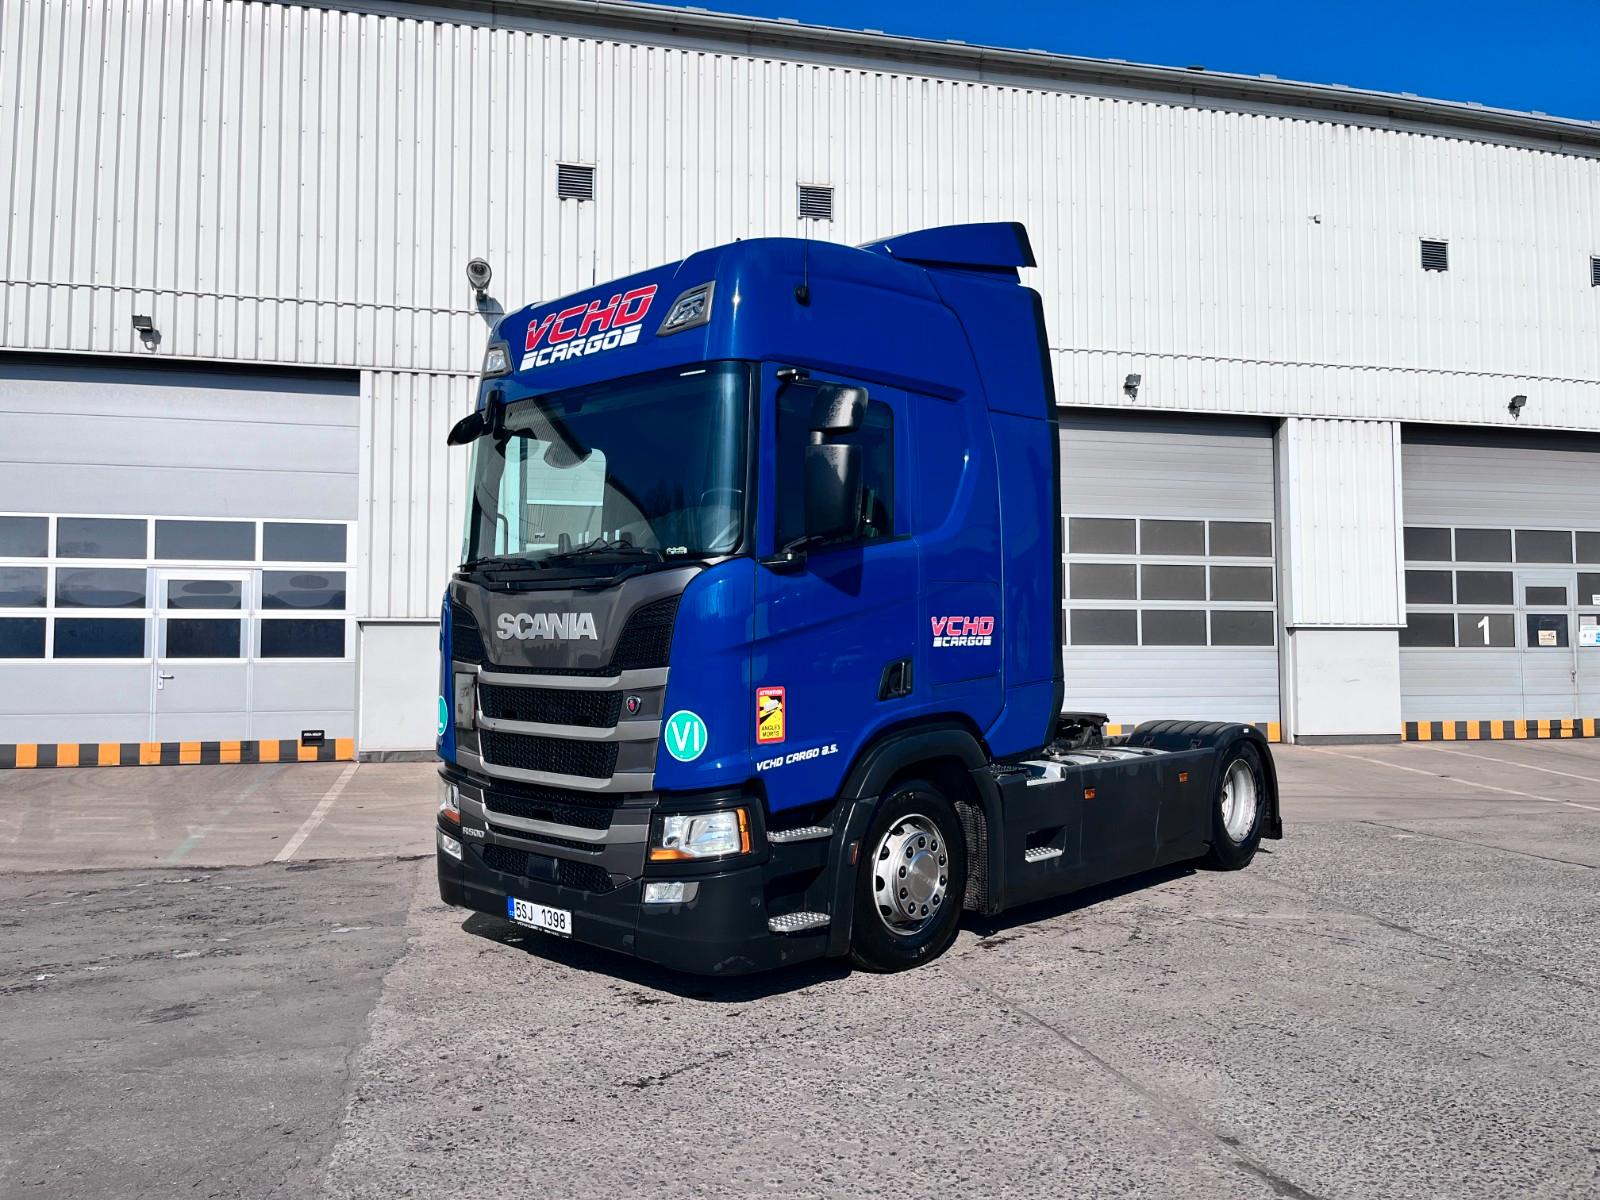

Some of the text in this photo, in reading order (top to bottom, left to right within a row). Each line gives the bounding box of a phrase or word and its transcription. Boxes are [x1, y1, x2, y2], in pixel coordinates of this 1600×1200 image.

[525, 284, 658, 351] VCHO
[536, 329, 622, 367] CARGO
[496, 612, 598, 641] SCANIA
[931, 616, 995, 636] VCHO
[1477, 615, 1490, 645] 1
[942, 636, 984, 647] CARGO
[671, 721, 700, 752] VI
[756, 757, 784, 772] VCHO
[786, 748, 820, 765] CARGO
[462, 826, 485, 838] R500
[516, 901, 533, 921] 5SJ
[541, 908, 566, 930] 1398
